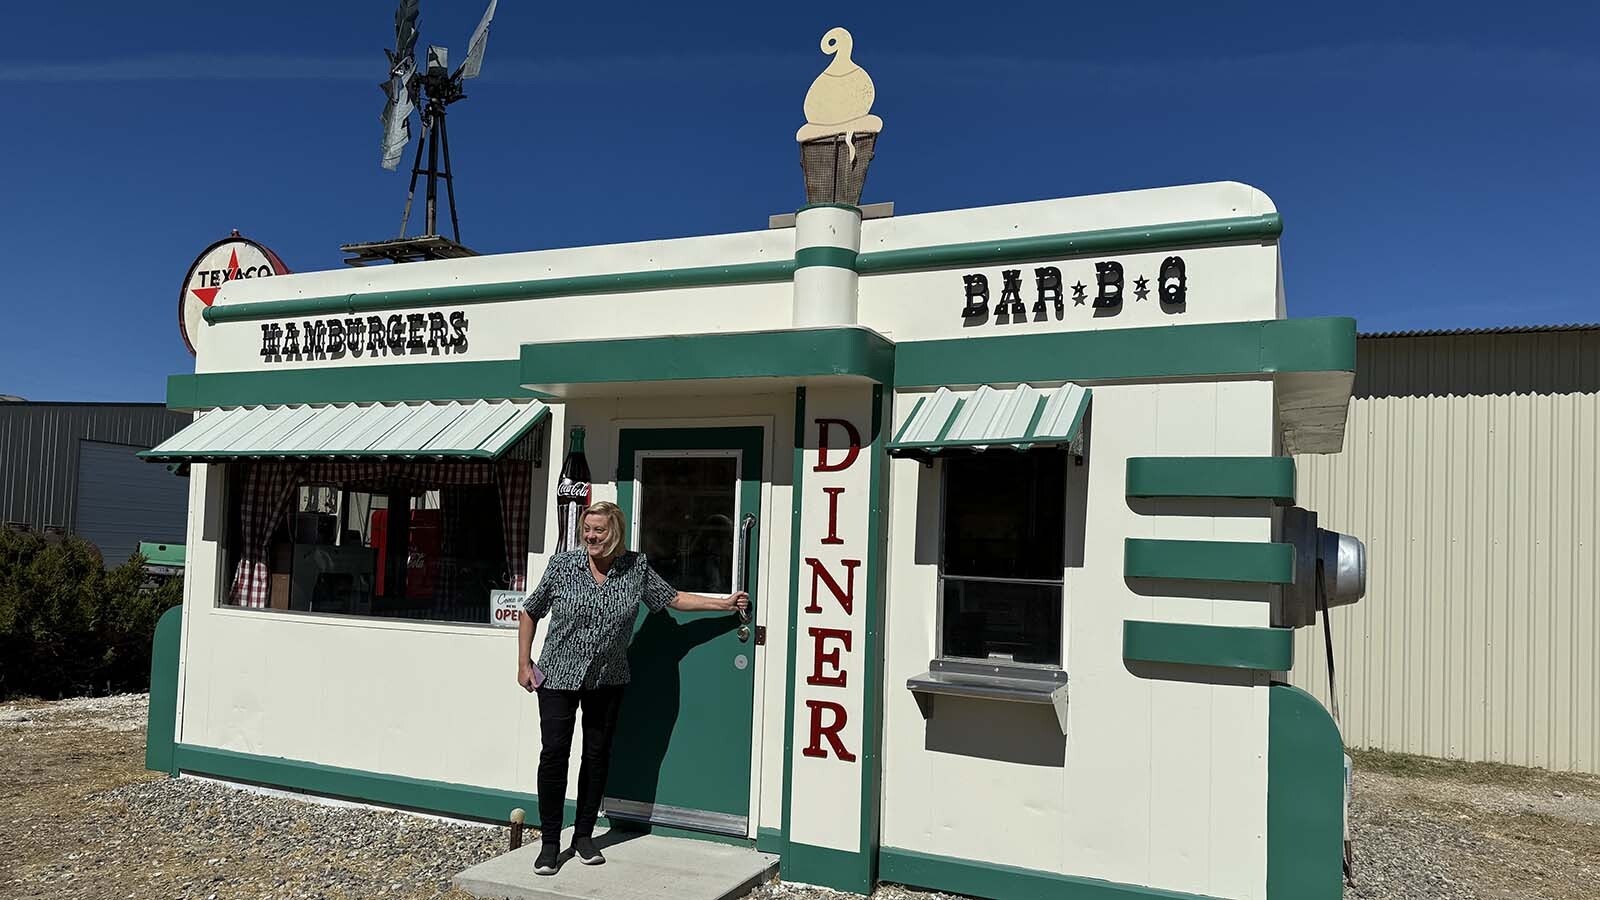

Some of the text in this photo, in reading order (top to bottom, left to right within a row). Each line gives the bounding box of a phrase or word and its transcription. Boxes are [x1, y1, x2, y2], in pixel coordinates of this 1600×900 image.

[198, 265, 272, 288] TEXACO
[260, 311, 468, 359] HAMBURGERS
[497, 593, 516, 605] Come
[803, 418, 861, 762] DINER
